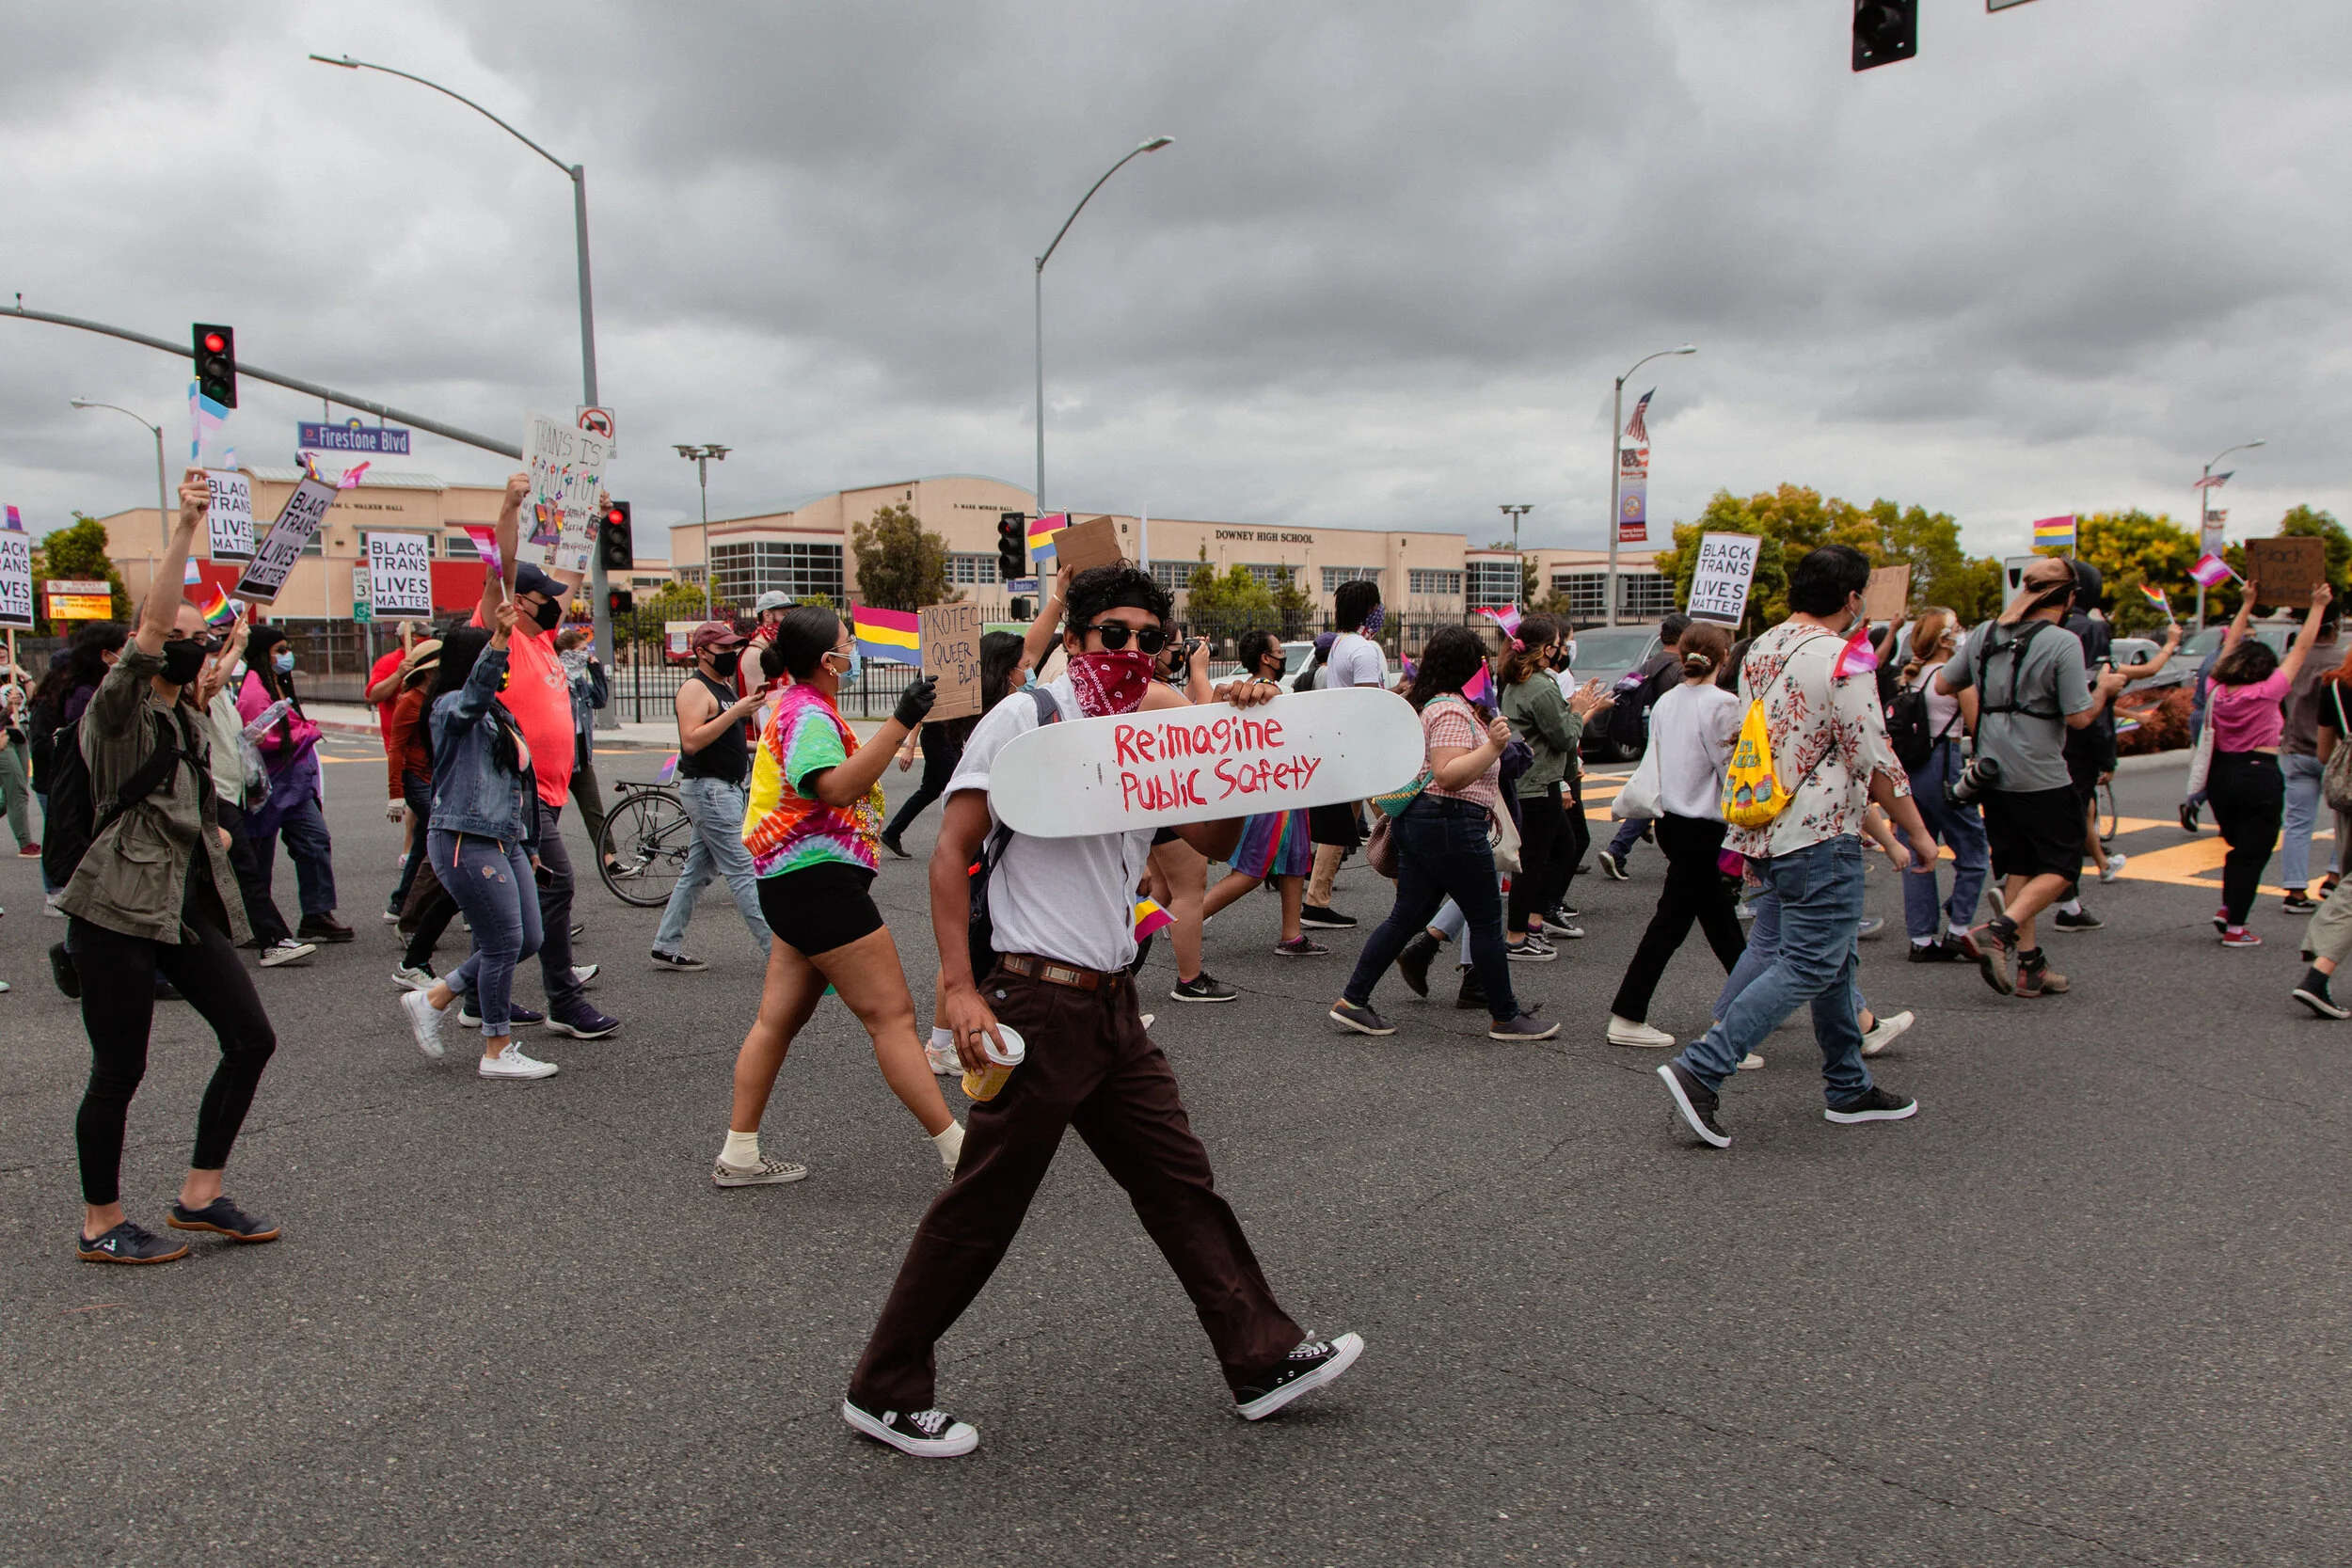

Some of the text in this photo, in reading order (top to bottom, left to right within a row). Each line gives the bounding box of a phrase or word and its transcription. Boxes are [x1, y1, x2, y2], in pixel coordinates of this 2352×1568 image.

[320, 426, 407, 452] Firestone Blvd
[534, 420, 602, 467] TRANS IS
[208, 480, 249, 498] BLACK
[210, 497, 251, 515] TRANS
[291, 491, 327, 517] BLACK
[211, 518, 253, 539] LIVES
[280, 511, 317, 537] TRANS
[213, 537, 254, 552] MATTER
[1216, 530, 1314, 544] DOWNEY HIGH SCHOOL
[2, 540, 26, 558] ACK
[259, 539, 299, 566] LIVES
[372, 541, 425, 557] BLACK
[1703, 544, 1752, 561] BLACK
[0, 558, 28, 574] ANS
[246, 563, 287, 584] MATTER
[373, 557, 427, 572] TRANS
[1700, 559, 1750, 577] TRANS
[0, 580, 29, 599] VES
[375, 577, 429, 594] LIVES
[1694, 579, 1744, 600] LIVES
[375, 594, 430, 608] MATTER
[1691, 598, 1742, 614] MATTER
[923, 607, 979, 641] PROTEC
[931, 641, 974, 671] QUEER
[1115, 715, 1285, 768] Reimagine
[1214, 754, 1322, 800] Safety
